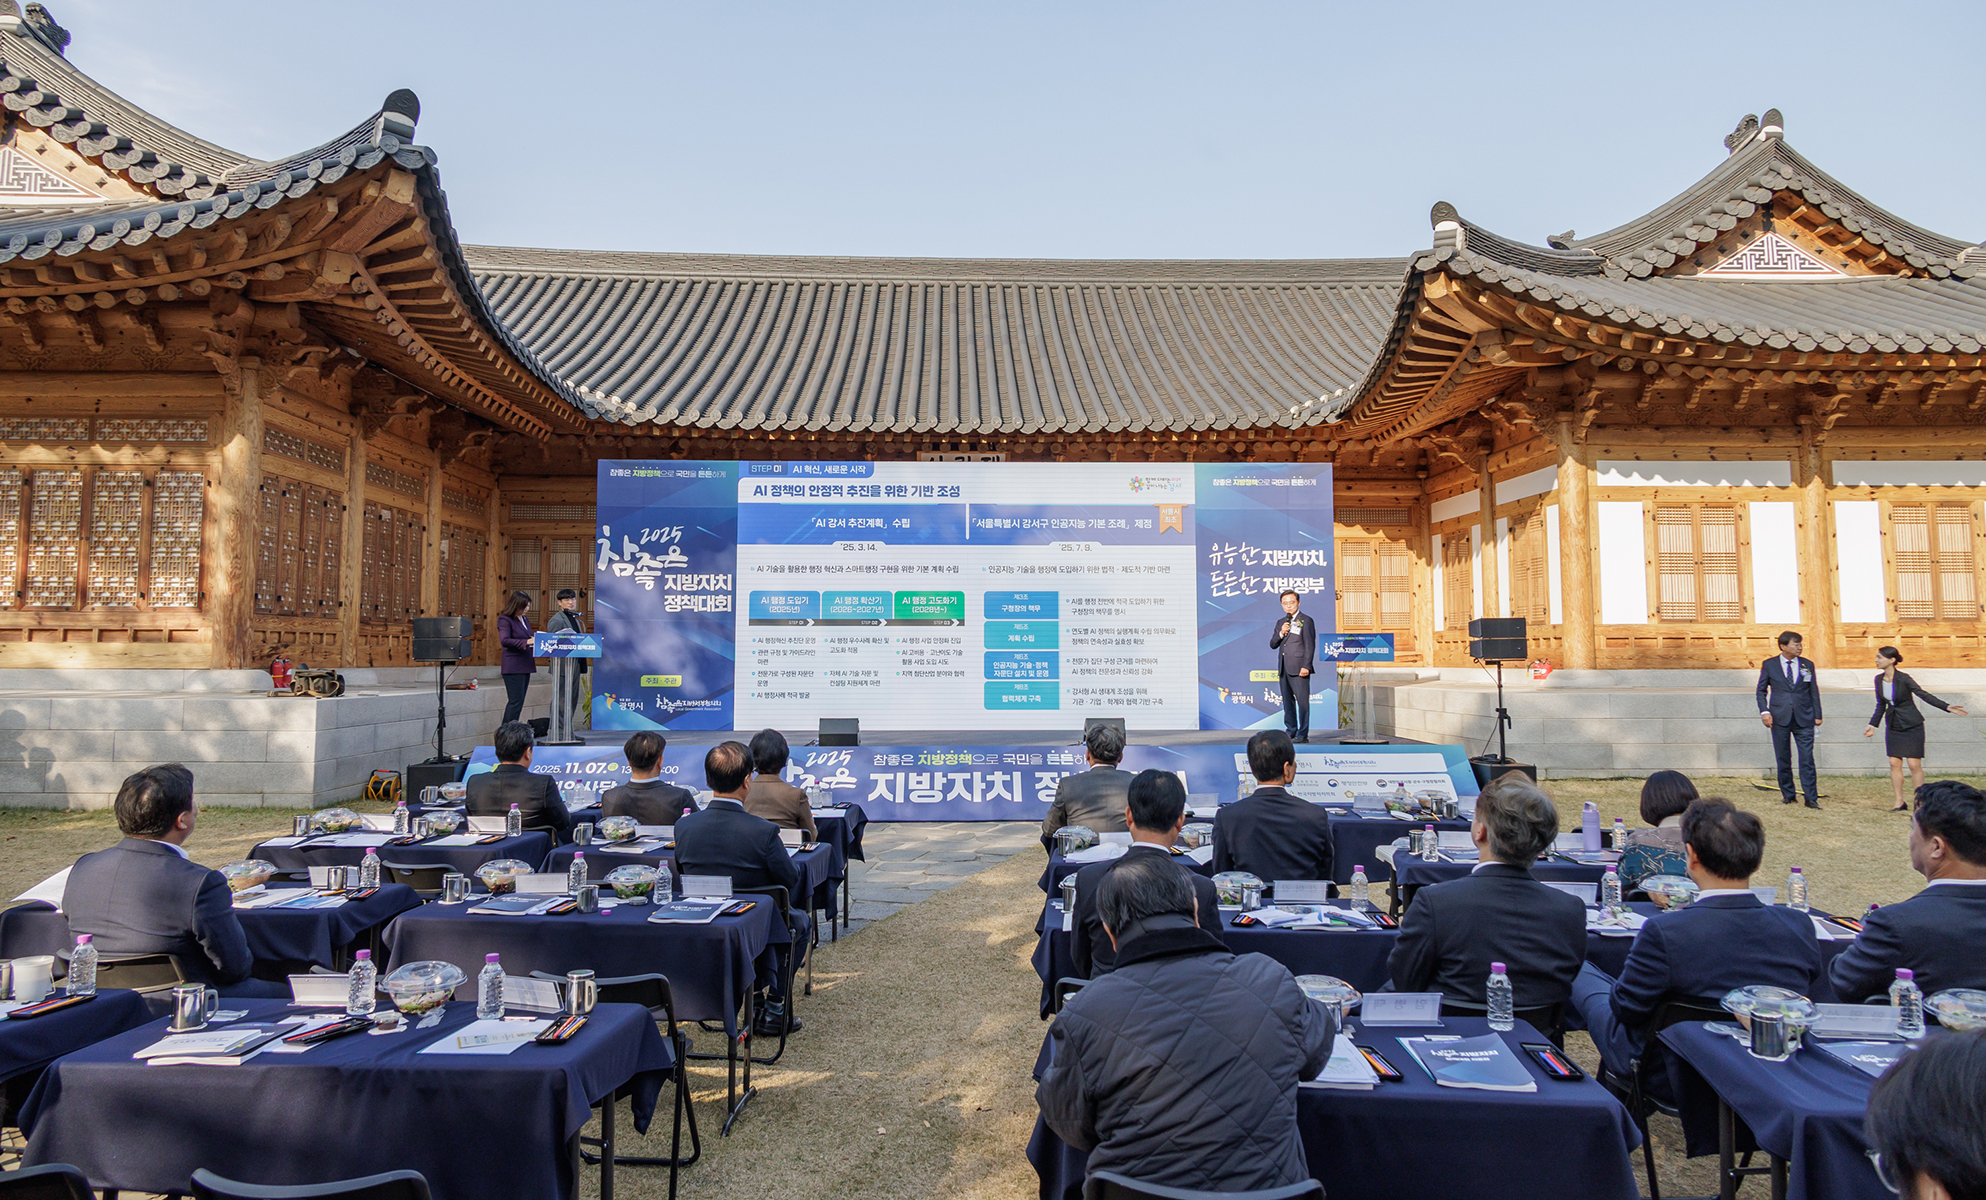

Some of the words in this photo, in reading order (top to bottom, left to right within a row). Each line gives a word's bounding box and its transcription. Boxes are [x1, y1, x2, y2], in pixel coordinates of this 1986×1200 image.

[610, 469, 631, 477] 참좋은
[633, 469, 674, 477] 지방정책으로
[676, 470, 696, 478] 국민을
[698, 470, 726, 478] 든든하게
[804, 465, 822, 474] 혁신,
[824, 465, 848, 474] 새로운
[850, 465, 866, 474] 시작
[753, 486, 767, 496] AI
[771, 485, 805, 497] 정책의
[809, 485, 843, 497] 안정적
[847, 485, 881, 497] 추진을
[884, 485, 908, 497] 위한
[911, 485, 934, 497] 기반
[937, 485, 960, 497] 조성
[828, 518, 846, 528] 강서
[893, 518, 910, 528] 수립
[1022, 518, 1049, 529] 강서구
[1051, 518, 1086, 529] 인공지능
[1088, 518, 1106, 529] 기본
[1135, 518, 1152, 529] 제정
[640, 526, 684, 545] 2025
[1209, 542, 1261, 566] 유능한
[1262, 550, 1327, 566] 지방자치,
[766, 565, 786, 573] 기술을
[788, 565, 808, 573] 활용한
[809, 565, 822, 573] 행정
[824, 565, 844, 573] 혁신과
[845, 565, 878, 573] 스마트행정
[880, 565, 900, 573] 구현을
[901, 565, 915, 573] 위한
[916, 565, 929, 573] 기본
[931, 565, 944, 573] 계획
[946, 565, 959, 573] 수립
[989, 566, 1015, 574] 인공지능
[1016, 566, 1036, 574] 기술을
[1038, 566, 1057, 574] 행정에
[1059, 566, 1085, 574] 도입하기
[1087, 566, 1100, 574] 위한
[1102, 566, 1115, 574] 법적
[1121, 566, 1141, 574] 제도적
[1143, 566, 1156, 574] 기반
[1158, 566, 1170, 574] 마련
[664, 574, 732, 591] 지방자치
[1211, 571, 1261, 597] 든든한
[1263, 577, 1324, 594] 지방정부
[664, 595, 732, 612] 정책대회
[771, 596, 785, 605] 행정
[787, 596, 809, 605] 도입기
[845, 596, 859, 605] 행정
[861, 596, 882, 605] 확산기
[913, 596, 927, 605] 행정
[928, 596, 957, 605] 고도화기
[1231, 696, 1253, 704] 광명시
[619, 702, 644, 711] 광명시
[805, 750, 854, 767] 2025
[874, 754, 914, 766] 참좋은
[918, 754, 999, 766] 지방정책으로
[1003, 754, 1043, 766] 국민을
[1047, 754, 1087, 766] 든든하
[533, 765, 561, 773] 2025.
[566, 763, 582, 773] 11.
[586, 763, 607, 773] 07.
[868, 771, 1023, 803] 지방자치
